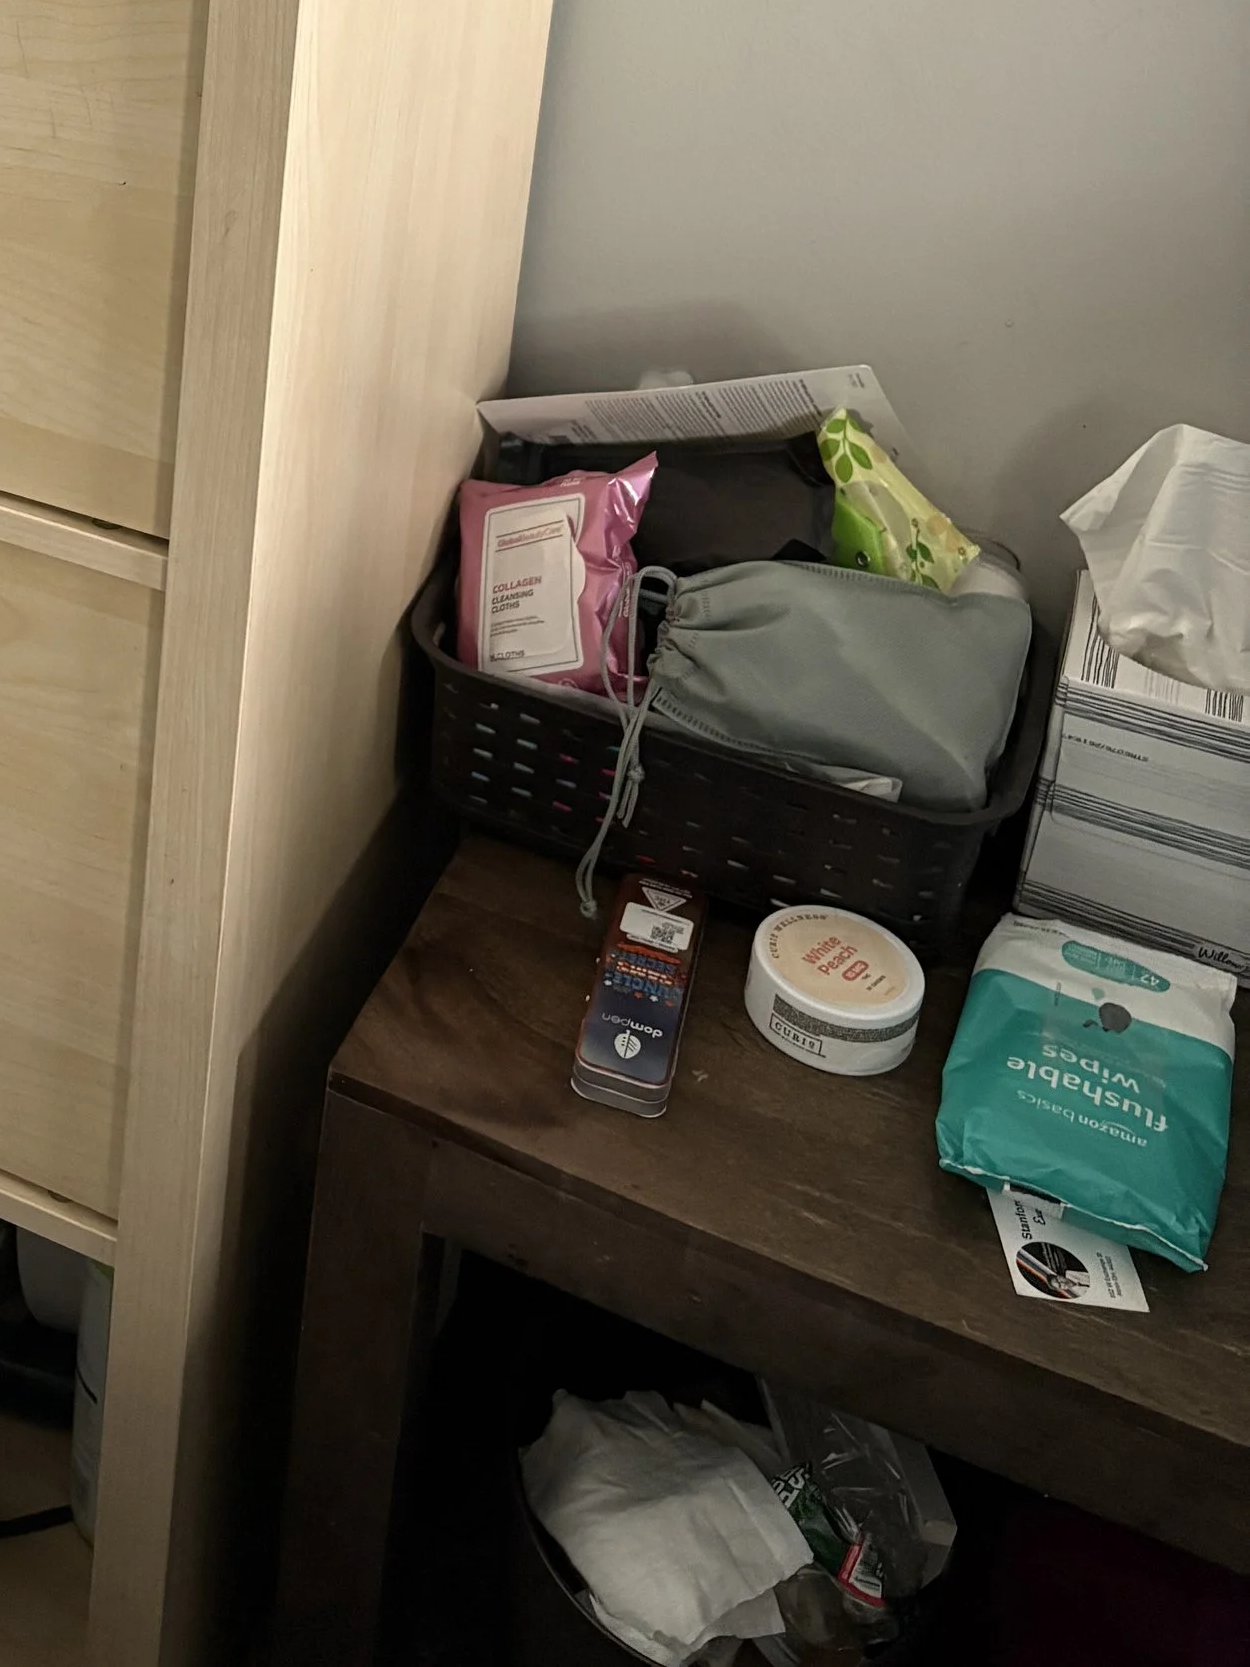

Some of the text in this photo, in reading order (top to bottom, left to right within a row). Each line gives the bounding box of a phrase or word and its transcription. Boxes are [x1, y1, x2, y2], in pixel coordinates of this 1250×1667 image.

[491, 589, 535, 605] CLEANSING
[492, 575, 543, 594] COLLAGEN
[491, 600, 521, 614] CLOTHS
[802, 936, 842, 964] White
[817, 945, 858, 976] Peach
[602, 1012, 664, 1039] dompen
[1042, 1044, 1140, 1094] wipes
[1006, 1056, 1168, 1132] flushable
[1016, 1089, 1148, 1147] amazon basics
